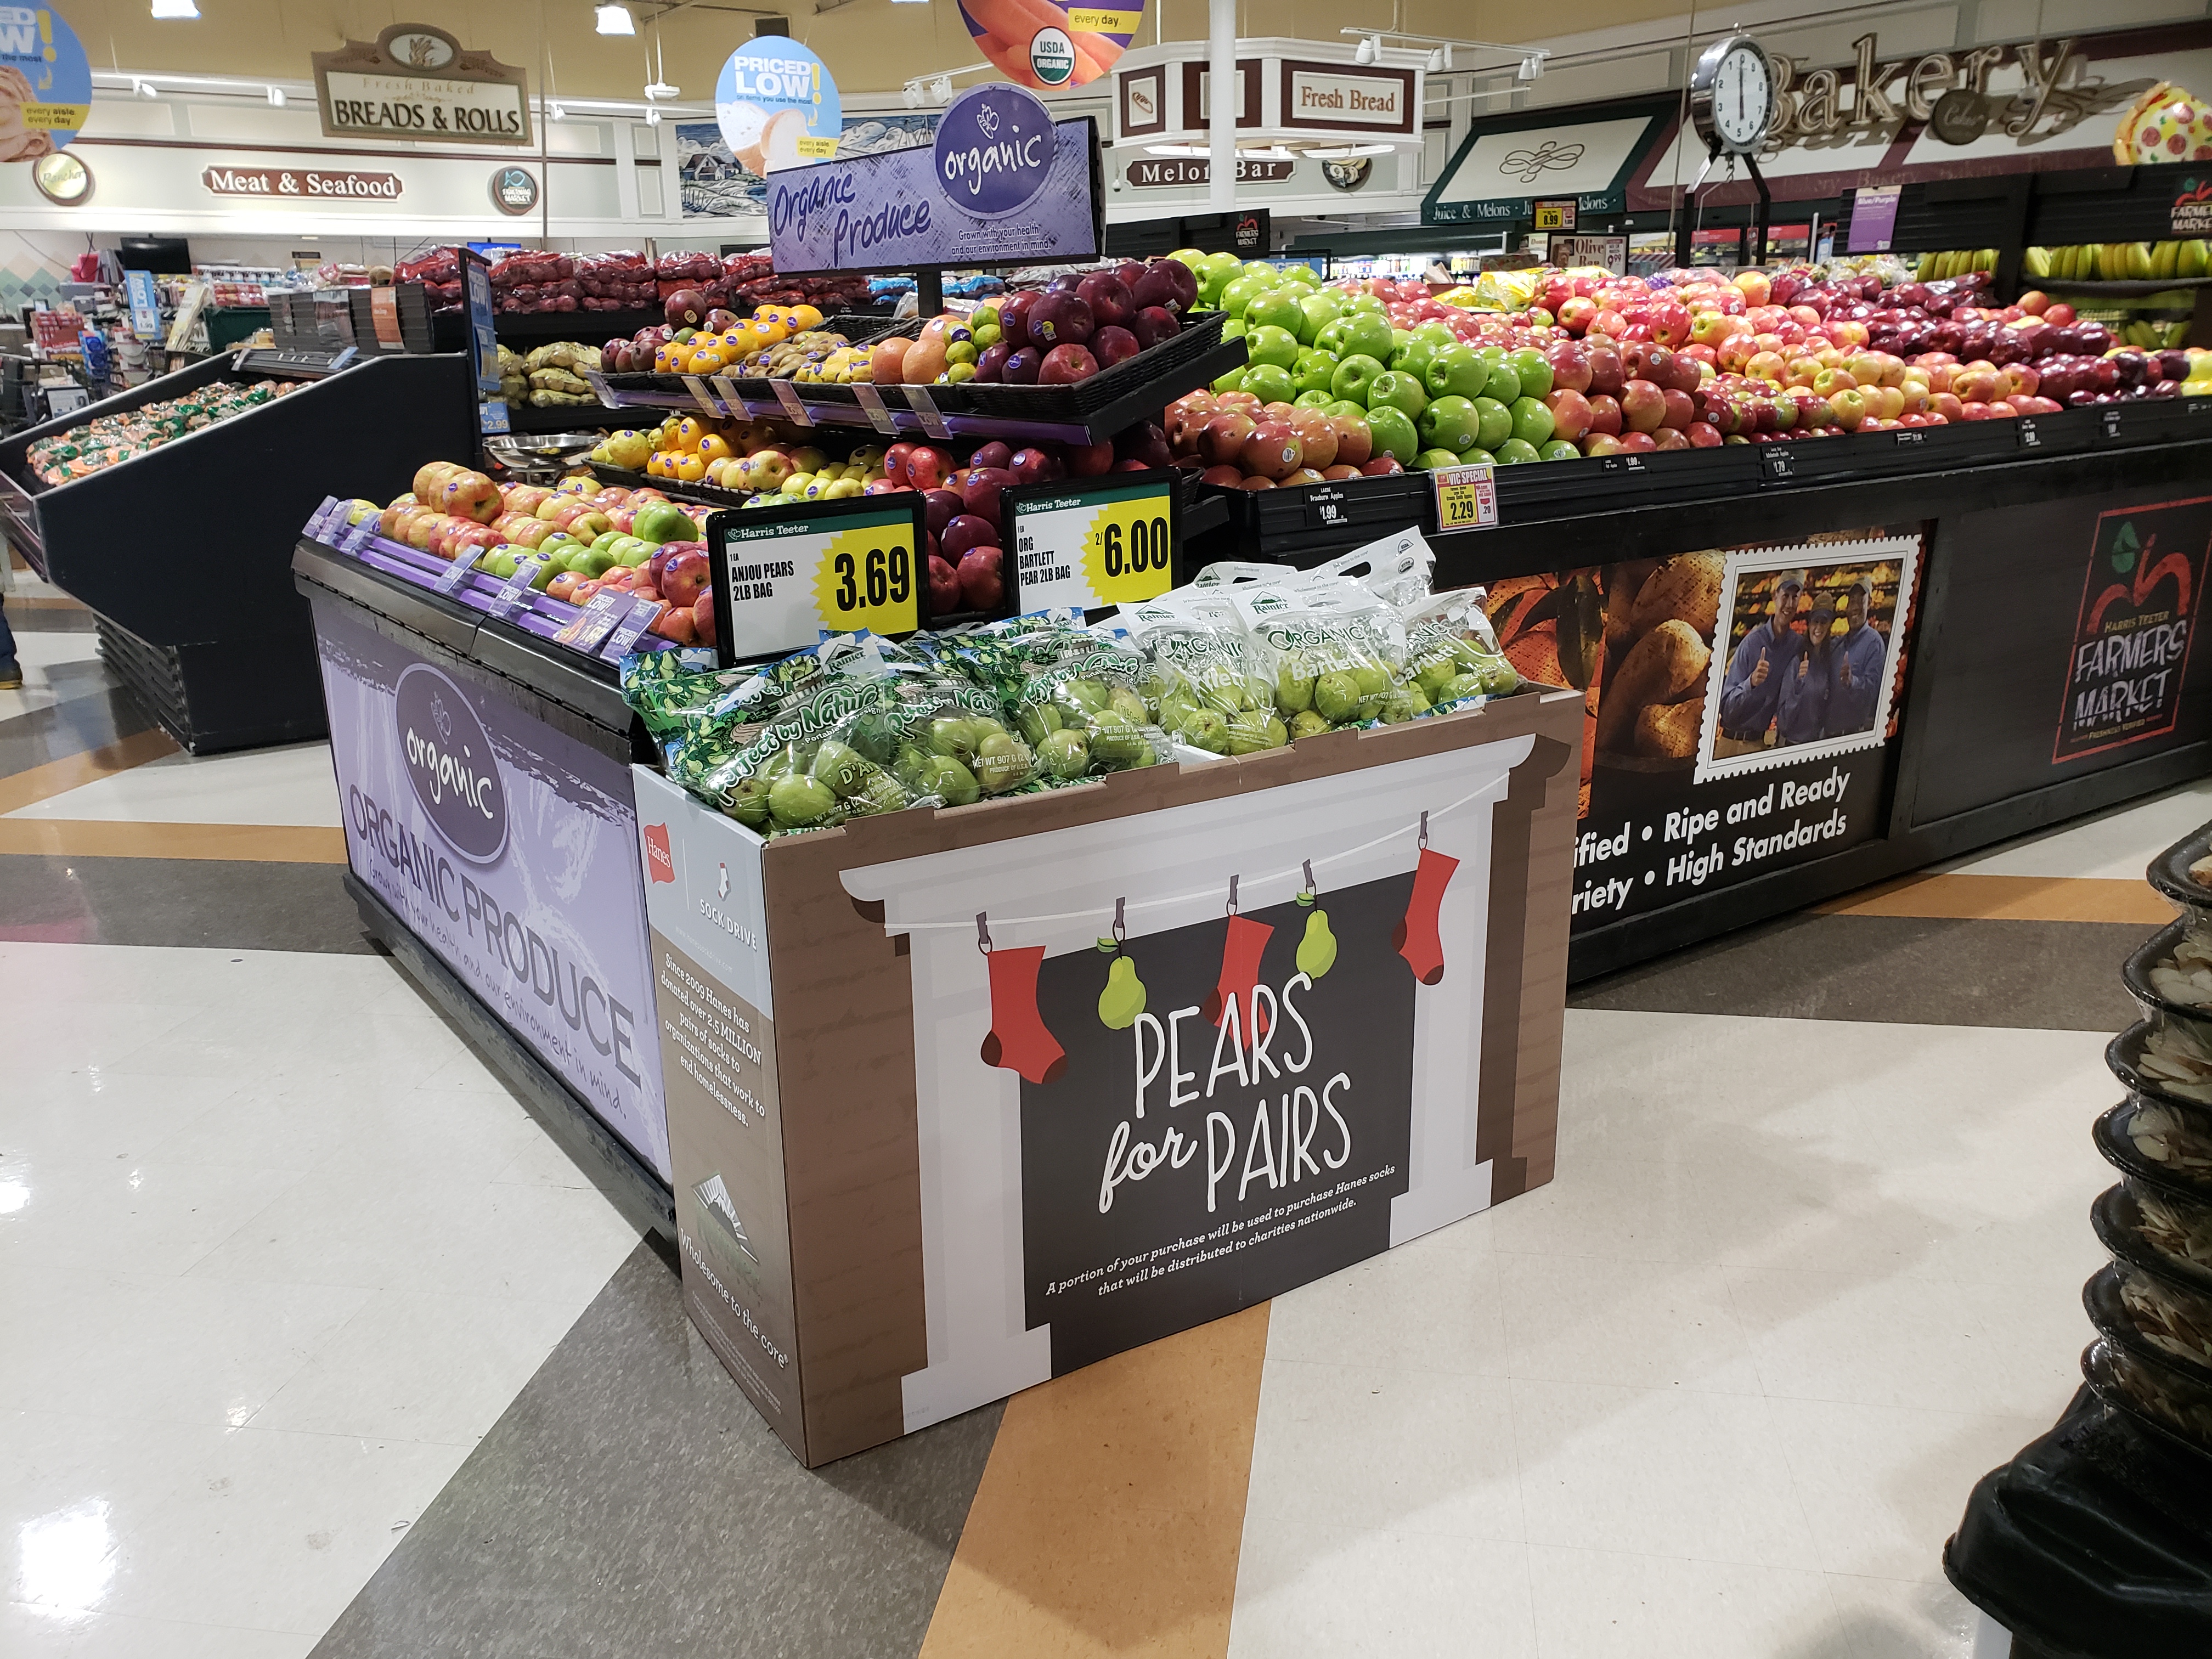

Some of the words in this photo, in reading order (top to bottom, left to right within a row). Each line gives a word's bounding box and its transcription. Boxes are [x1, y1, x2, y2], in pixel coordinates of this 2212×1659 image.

[1074, 15, 1099, 26] every
[1040, 41, 1065, 54] USDA
[734, 57, 811, 76] PRICED
[1036, 58, 1069, 69] ORGANIC
[362, 78, 412, 90] Fresh
[422, 83, 475, 95] Baked
[1301, 86, 1344, 109] Fresh
[1350, 89, 1395, 113] Bread
[334, 99, 425, 129] BREADS
[432, 106, 448, 130] &
[454, 106, 520, 134] ROLLS
[944, 125, 1043, 196] organic
[1235, 161, 1277, 178] Bar
[210, 169, 269, 193] Meat
[278, 172, 299, 194] &
[306, 173, 398, 198] Seafood
[774, 167, 856, 242] Organic
[1433, 206, 1457, 221] Juice
[1462, 205, 1472, 219] &
[1477, 203, 1511, 218] Melons
[958, 229, 981, 240] Grown
[983, 226, 997, 238] with
[1000, 228, 1015, 240] your
[1017, 222, 1039, 236] health
[1543, 215, 1559, 225] 8.99
[833, 200, 932, 267] Produce
[951, 247, 963, 256] and
[966, 245, 977, 255] our
[978, 240, 1020, 253] environment
[1022, 239, 1029, 251] in
[1031, 236, 1051, 250] mind.
[1576, 239, 1604, 254] Olive
[1448, 472, 1461, 486] VIC
[1461, 469, 1488, 484] SPECIAL
[1026, 502, 1053, 512] Harris
[1054, 498, 1081, 508] Teeter
[1319, 504, 1337, 520] $1.99
[1450, 500, 1474, 521] 2.29
[741, 528, 775, 539] Harris
[776, 524, 809, 535] Teeter
[1018, 536, 1034, 553] ORG
[1104, 516, 1169, 578] 6.00
[732, 563, 763, 583] ANJOU
[764, 560, 794, 578] PEARS
[1019, 550, 1055, 570] BARTLETT
[834, 545, 911, 612] 3.69
[1020, 570, 1039, 586] PEAR
[1040, 568, 1053, 583] 2LB
[1055, 565, 1070, 581] BAG
[733, 584, 752, 602] 2LB
[753, 582, 773, 598] BAG
[1137, 613, 1177, 622] Rainier
[1252, 603, 1289, 615] Rainier
[2104, 617, 2136, 633] HARRIS
[2137, 611, 2170, 626] TEETER
[1266, 626, 1365, 651] ORGANIC
[828, 650, 866, 673] Rainier
[1405, 644, 1460, 681] artlett
[2074, 619, 2188, 684] FARMERS
[799, 684, 878, 733] Nature
[2073, 668, 2173, 731] MARKET
[774, 721, 803, 741] by
[804, 725, 842, 744] Portable
[1114, 725, 1125, 733] 907
[984, 755, 996, 766] WT
[997, 754, 1011, 766] 907
[989, 766, 1010, 774] PRODUCE
[406, 726, 494, 820] organic
[828, 804, 843, 816] 907
[1572, 821, 1631, 868] ified
[1664, 806, 1718, 847] Ripe
[1726, 784, 1774, 825] and
[1780, 766, 1850, 811] Ready
[647, 835, 671, 868] Hanes
[1572, 876, 1634, 916] riety
[1667, 844, 1725, 887] High
[1732, 807, 1847, 872] Standards
[699, 898, 725, 930] SOCK
[726, 916, 758, 951] DRIVE
[349, 783, 460, 923] ORGANIC
[459, 871, 642, 1094] PRODUCE
[369, 858, 390, 890] Grown
[390, 880, 409, 909] with
[410, 901, 429, 928] your
[428, 911, 462, 962] health
[463, 953, 483, 981] and
[485, 973, 500, 996] our
[504, 990, 572, 1065] environment
[665, 952, 685, 981] Since
[685, 972, 705, 1001] 2009
[706, 986, 732, 1021] Hanes
[733, 1006, 751, 1034] has
[661, 969, 690, 1007] donated
[690, 998, 707, 1022] over
[707, 1013, 720, 1036] 2.5
[720, 1021, 761, 1066] MILLION
[679, 1012, 698, 1038] pairs
[699, 1029, 708, 1045] of
[708, 1038, 730, 1066] socks
[731, 1056, 741, 1073] to
[1133, 971, 1312, 1119] PEARS
[665, 1019, 714, 1074] organizations
[714, 1063, 732, 1090] that
[732, 1080, 754, 1110] work
[755, 1098, 766, 1118] to
[680, 1055, 694, 1076] end
[693, 1059, 749, 1127] homelessness.
[1098, 1120, 1199, 1214] for
[1206, 1071, 1352, 1212] PAIRS
[1045, 1281, 1057, 1296] A
[1057, 1266, 1104, 1295] portion
[1106, 1257, 1121, 1274] of
[1119, 1251, 1149, 1272] your
[1149, 1234, 1206, 1262] purchase
[1207, 1221, 1230, 1242] will
[1231, 1220, 1245, 1233] be
[1246, 1207, 1273, 1228] used
[1273, 1205, 1285, 1218] to
[1285, 1188, 1334, 1217] purchase
[1335, 1175, 1368, 1196] Hanes
[1368, 1164, 1396, 1182] socks
[1098, 1277, 1124, 1296] that
[1125, 1268, 1149, 1287] will
[1150, 1265, 1166, 1280] be
[1167, 1240, 1234, 1273] distributed
[1234, 1238, 1247, 1251] to
[1248, 1219, 1296, 1247] charities
[1296, 1196, 1357, 1228] nationwide.
[680, 1227, 730, 1304] Wholesome
[731, 1295, 741, 1318] to
[742, 1308, 759, 1340] the
